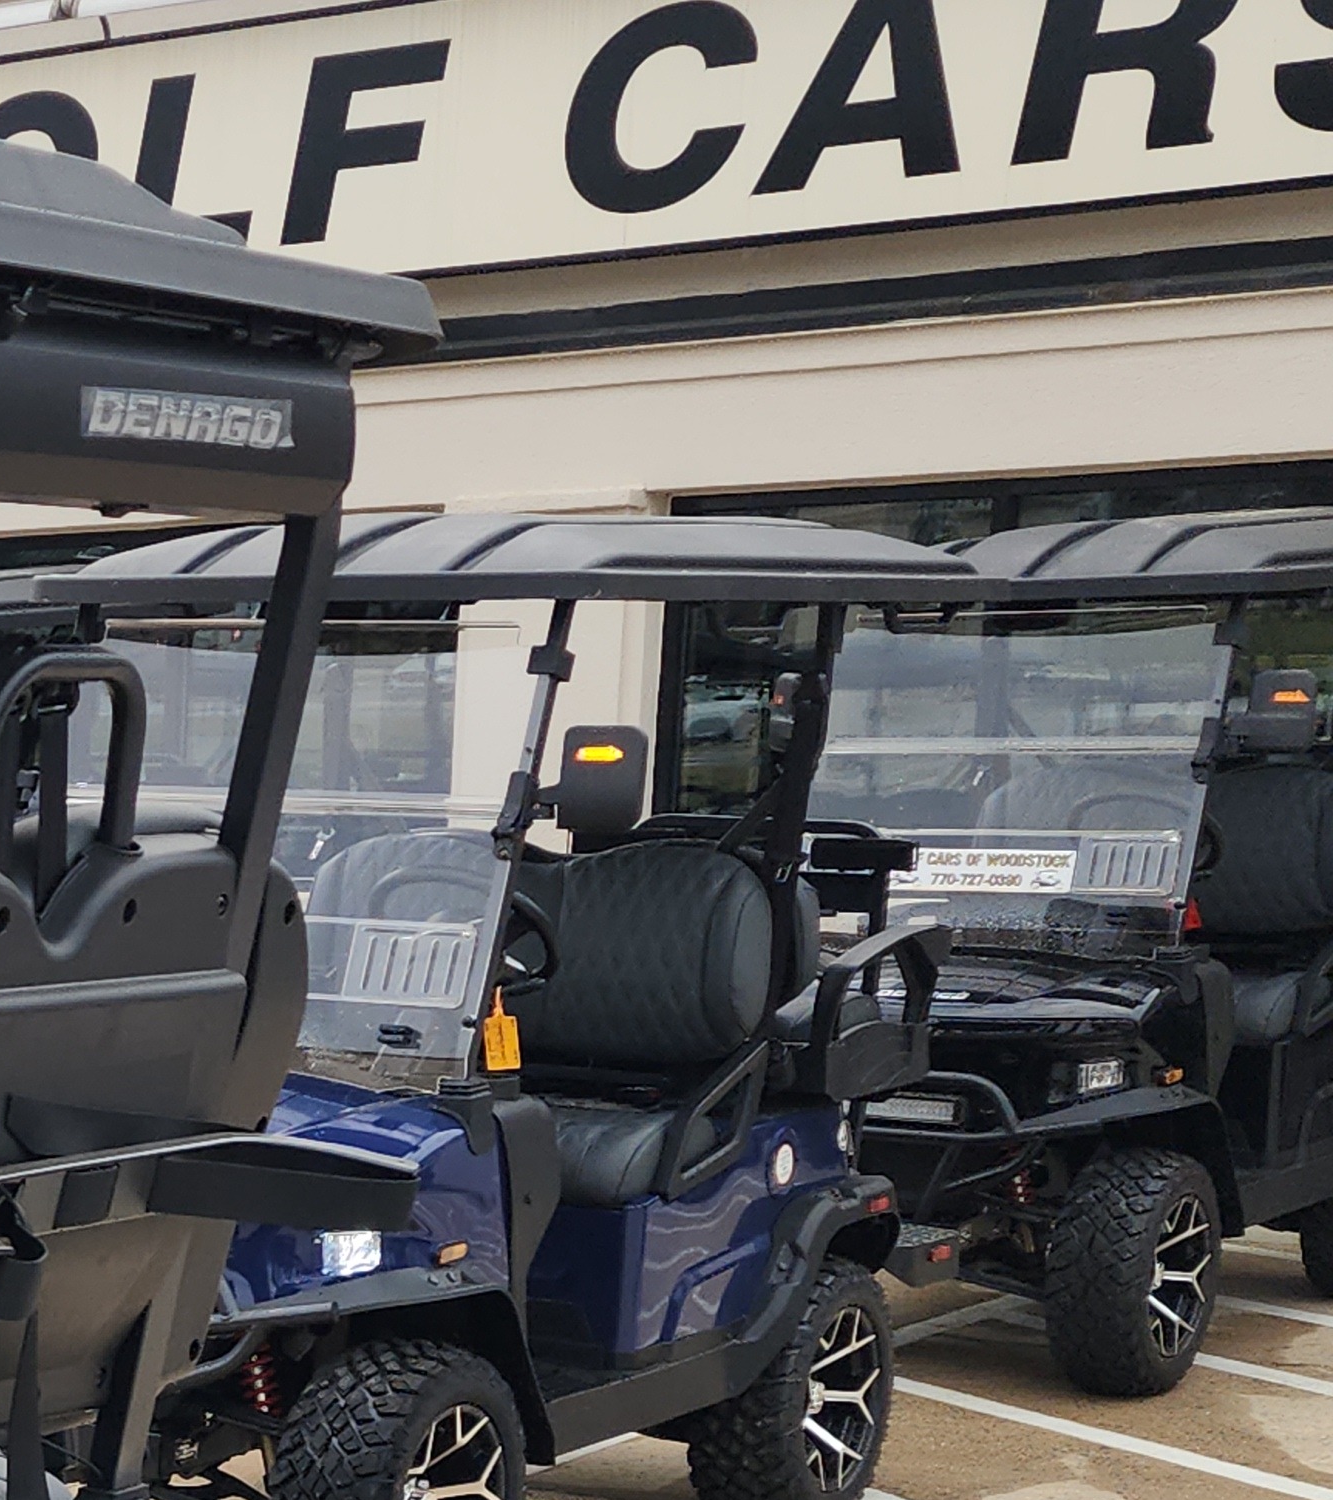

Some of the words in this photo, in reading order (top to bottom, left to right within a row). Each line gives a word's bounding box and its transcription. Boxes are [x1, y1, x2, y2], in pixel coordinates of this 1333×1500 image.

[564, 0, 1333, 214] CAR
[88, 388, 283, 450] DENAGO
[926, 852, 962, 866] CARS
[966, 853, 984, 866] OF
[986, 853, 1074, 868] WOODSTOCK
